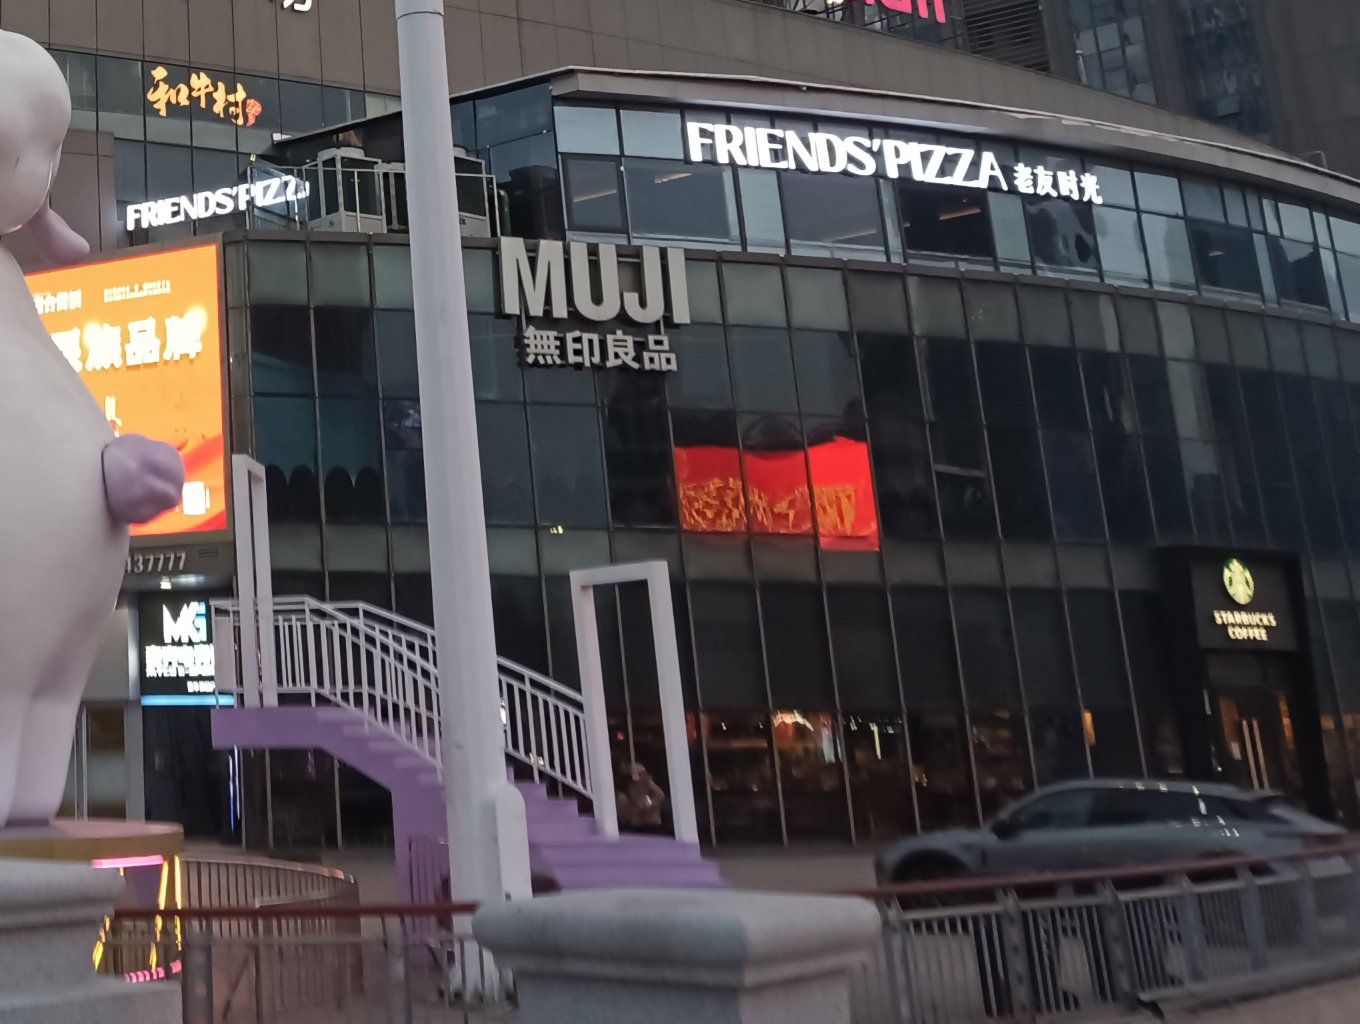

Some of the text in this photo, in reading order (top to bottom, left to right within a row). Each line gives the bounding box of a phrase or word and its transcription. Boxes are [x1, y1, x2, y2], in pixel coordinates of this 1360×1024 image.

[1013, 162, 1103, 205] 老友时光
[500, 236, 691, 325] MUJI
[523, 325, 678, 372] 無印良品
[1213, 610, 1277, 627] STARBUCKS
[1227, 625, 1269, 641] COFFEE
